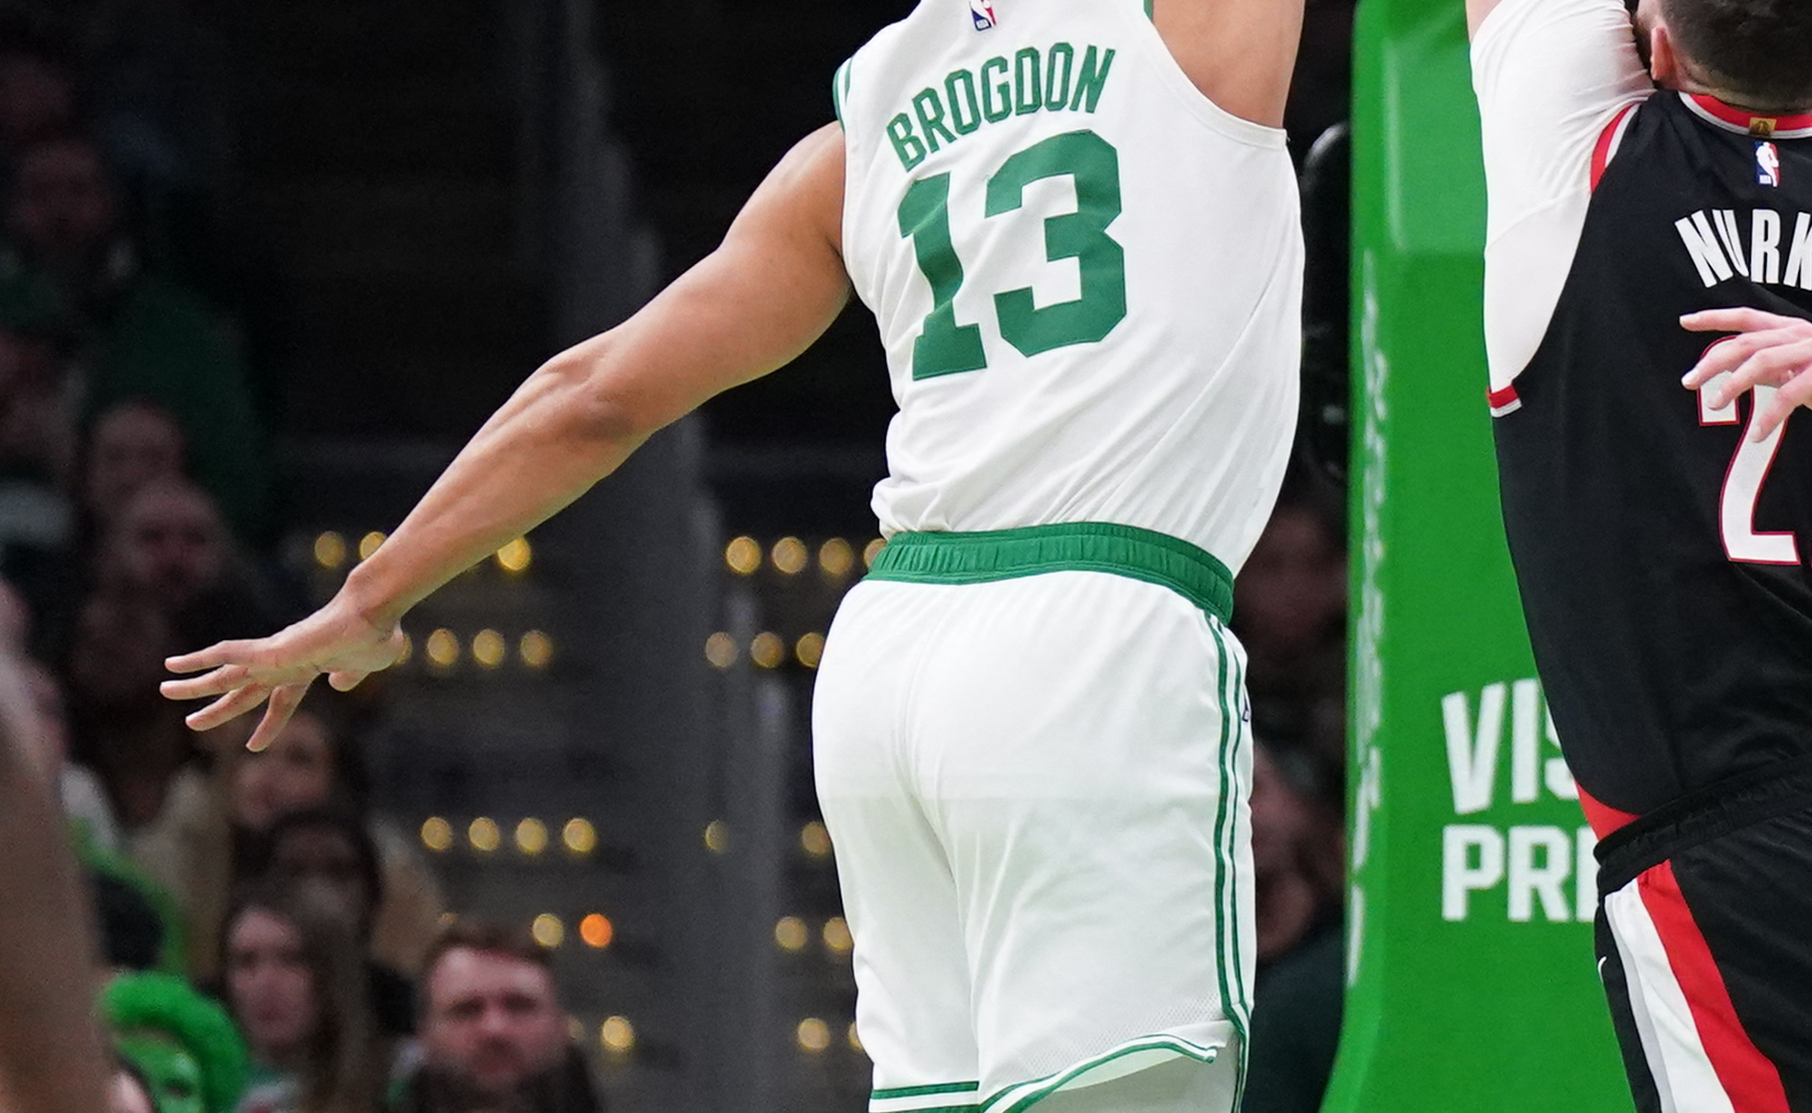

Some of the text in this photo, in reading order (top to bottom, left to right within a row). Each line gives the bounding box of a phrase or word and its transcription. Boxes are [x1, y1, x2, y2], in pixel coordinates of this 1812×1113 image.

[886, 42, 1116, 173] BROGDON
[897, 129, 1127, 381] 13
[1441, 824, 1600, 922] PRI
